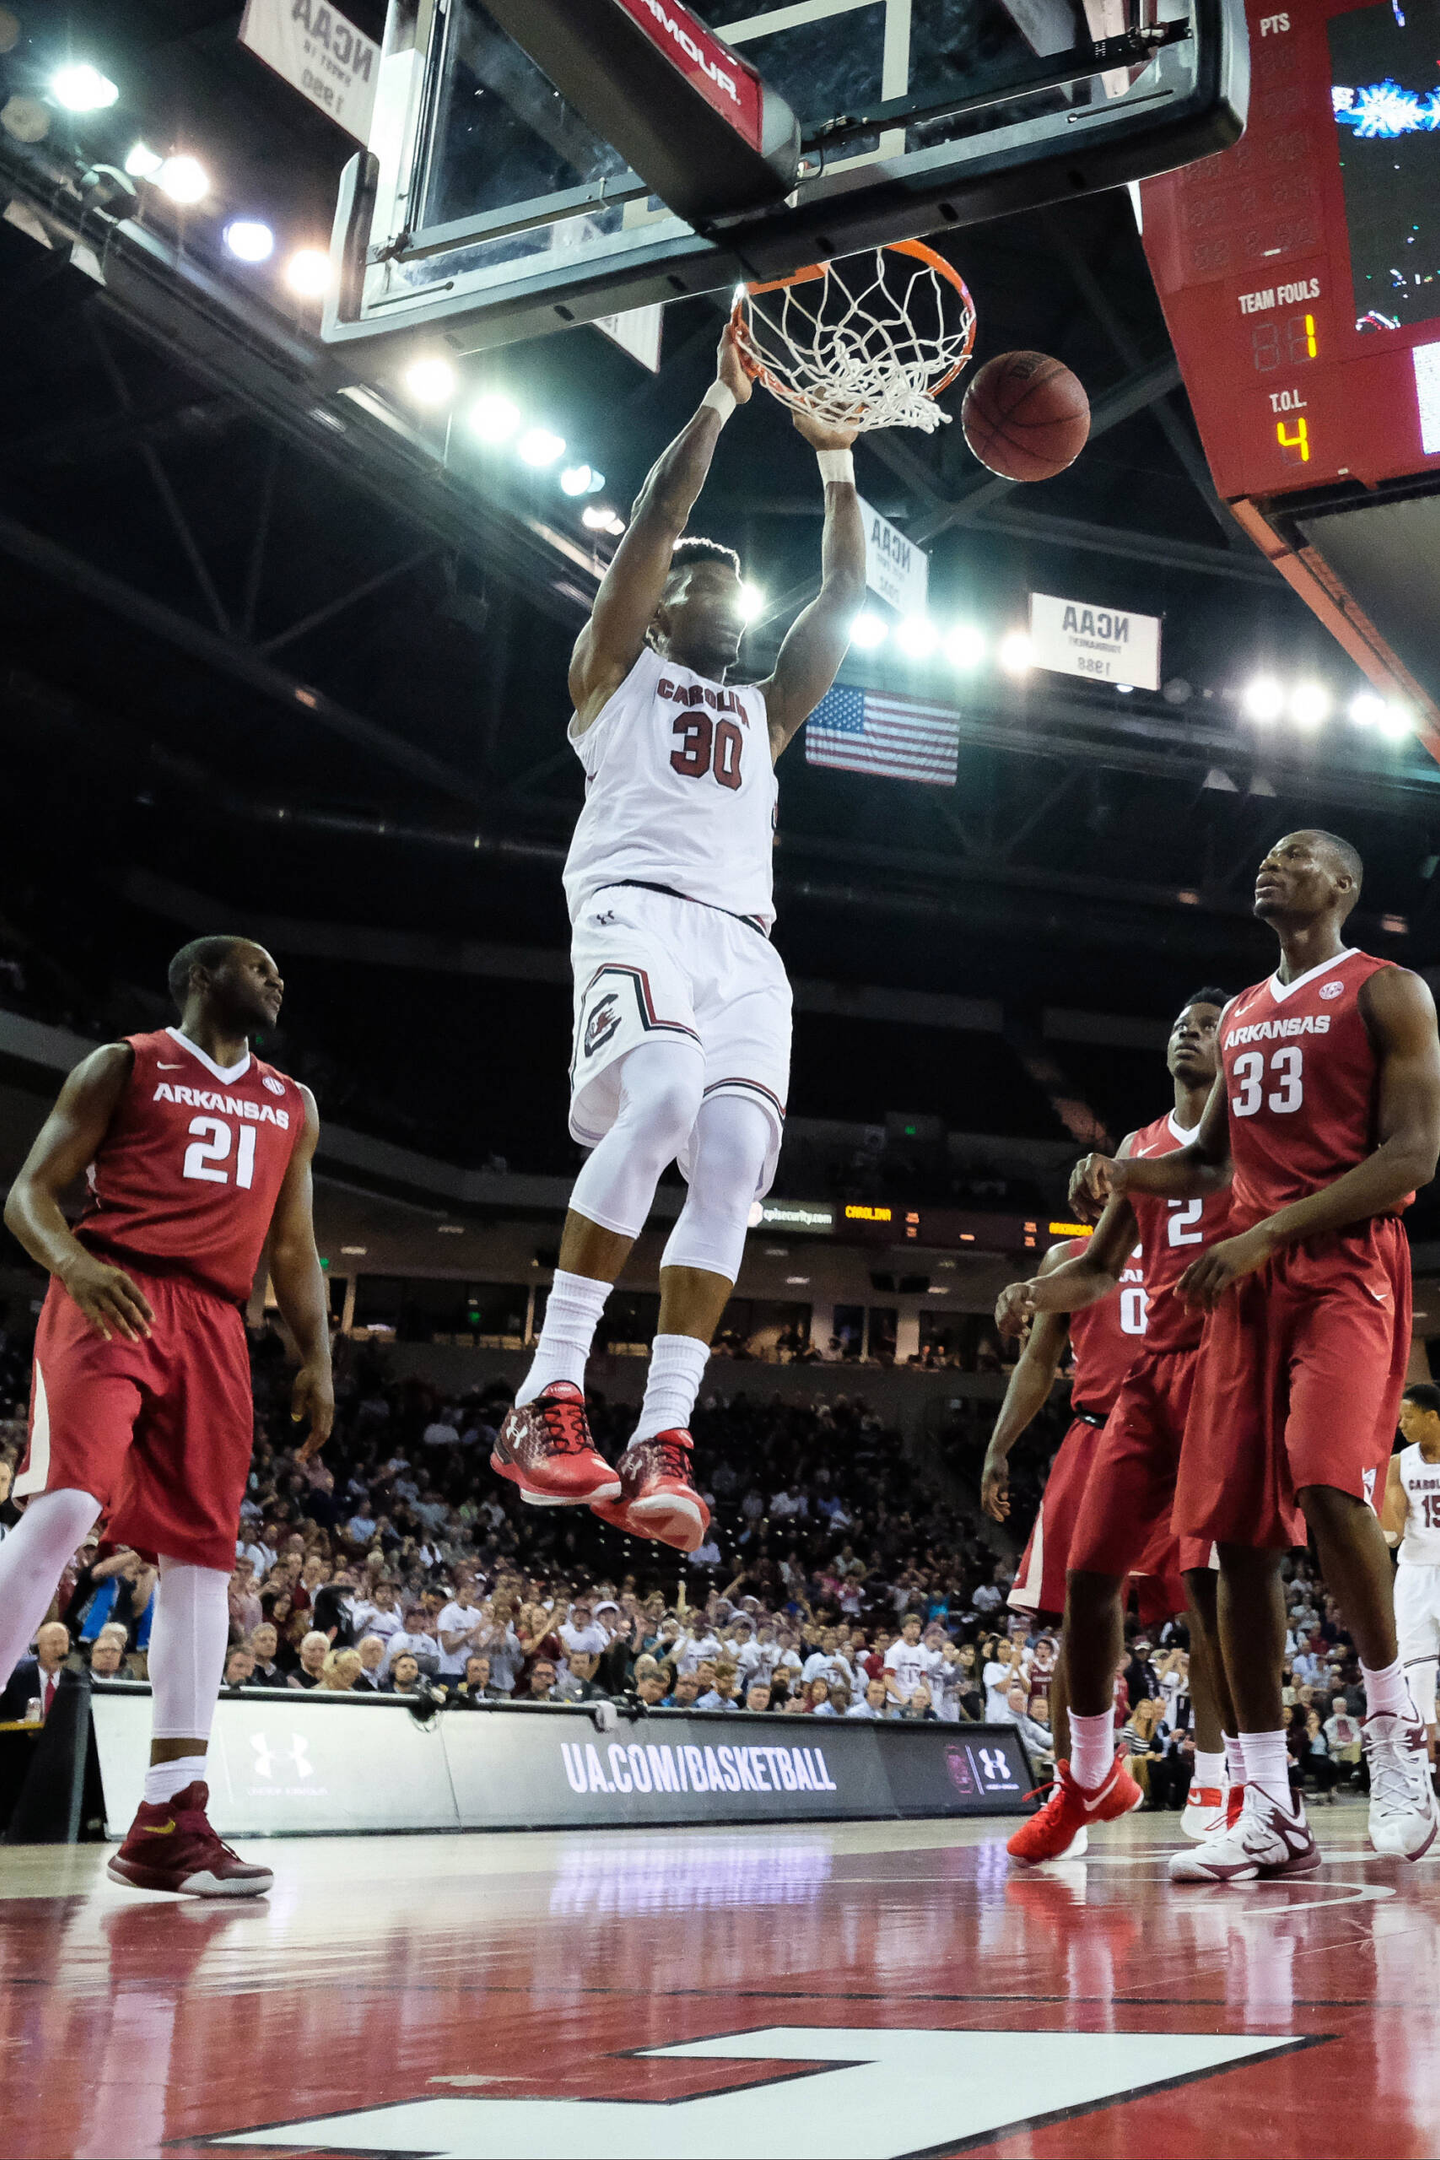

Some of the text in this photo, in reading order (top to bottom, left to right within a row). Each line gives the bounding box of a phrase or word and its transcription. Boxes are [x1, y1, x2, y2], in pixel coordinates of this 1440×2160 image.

[1259, 12, 1291, 37] PTS
[1238, 277, 1320, 315] TEAM FOULS
[1305, 314, 1317, 358] 1
[1269, 389, 1308, 413] T.O.L.
[1276, 417, 1310, 462] 4
[670, 711, 743, 791] 30
[1224, 1015, 1331, 1050] ARKANSAS
[1232, 1046, 1303, 1117] 33
[153, 1082, 289, 1130] ARKANSAS
[183, 1116, 256, 1189] 21
[845, 1205, 891, 1221] CAROLINA
[1168, 1199, 1202, 1247] 2
[1120, 1288, 1149, 1334] 0
[560, 1743, 837, 1793] UA.COM/BASKETBALL
